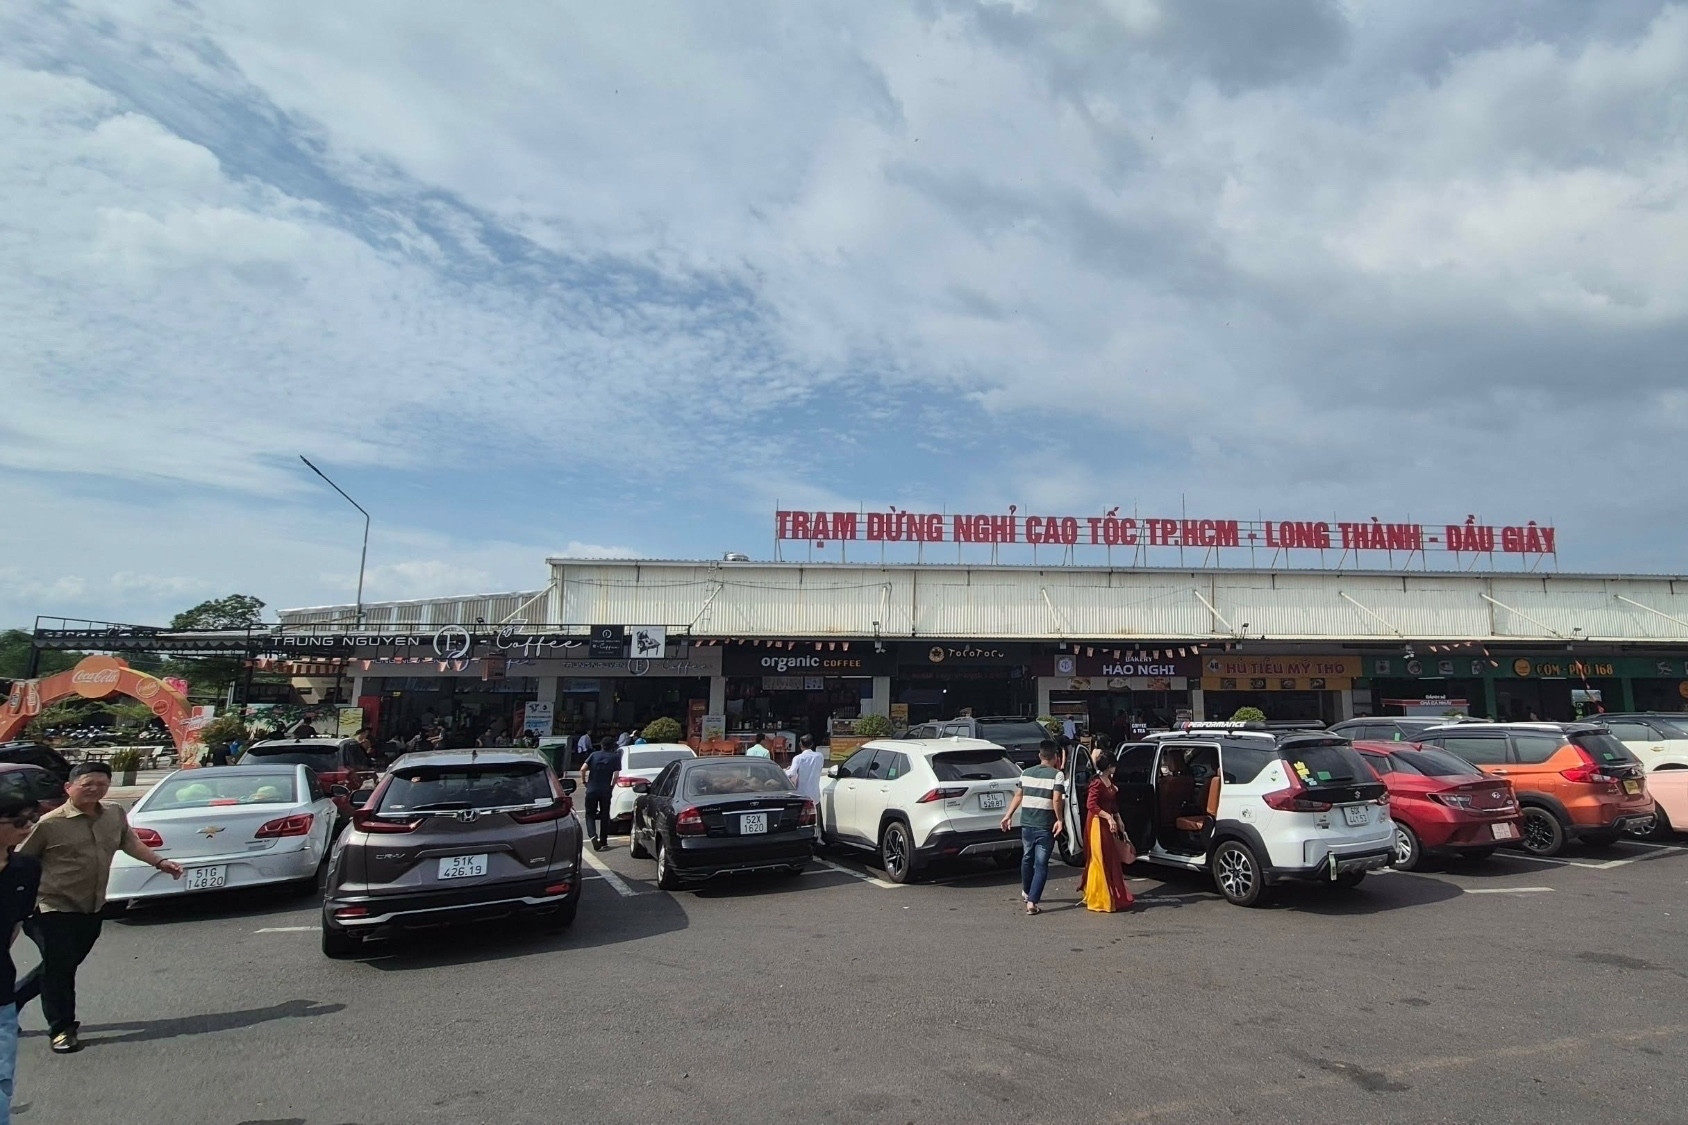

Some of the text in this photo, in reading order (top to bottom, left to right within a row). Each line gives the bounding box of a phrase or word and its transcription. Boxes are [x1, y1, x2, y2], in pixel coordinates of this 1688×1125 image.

[776, 511, 856, 548] TRẠM
[867, 506, 943, 541] DỪNG
[953, 505, 1017, 543] NGHỈ
[1026, 516, 1077, 545] CAO
[1087, 507, 1136, 545] TỐC
[1146, 519, 1239, 547] TP.HCM
[1265, 521, 1331, 549] LONG
[1338, 516, 1422, 550] THÀNH
[1502, 520, 1555, 553] GIÂY
[272, 636, 334, 647] TRUNG
[342, 636, 420, 647] NGUYEN
[496, 625, 582, 657] Coffee
[761, 655, 861, 672] organic COFFEE
[1138, 664, 1176, 675] NGHI
[1594, 664, 1613, 675] 168
[746, 815, 760, 824] 52X
[744, 824, 763, 832] 1620
[453, 856, 473, 866] 51K
[196, 867, 217, 879] 51G
[444, 865, 482, 877] 426.19
